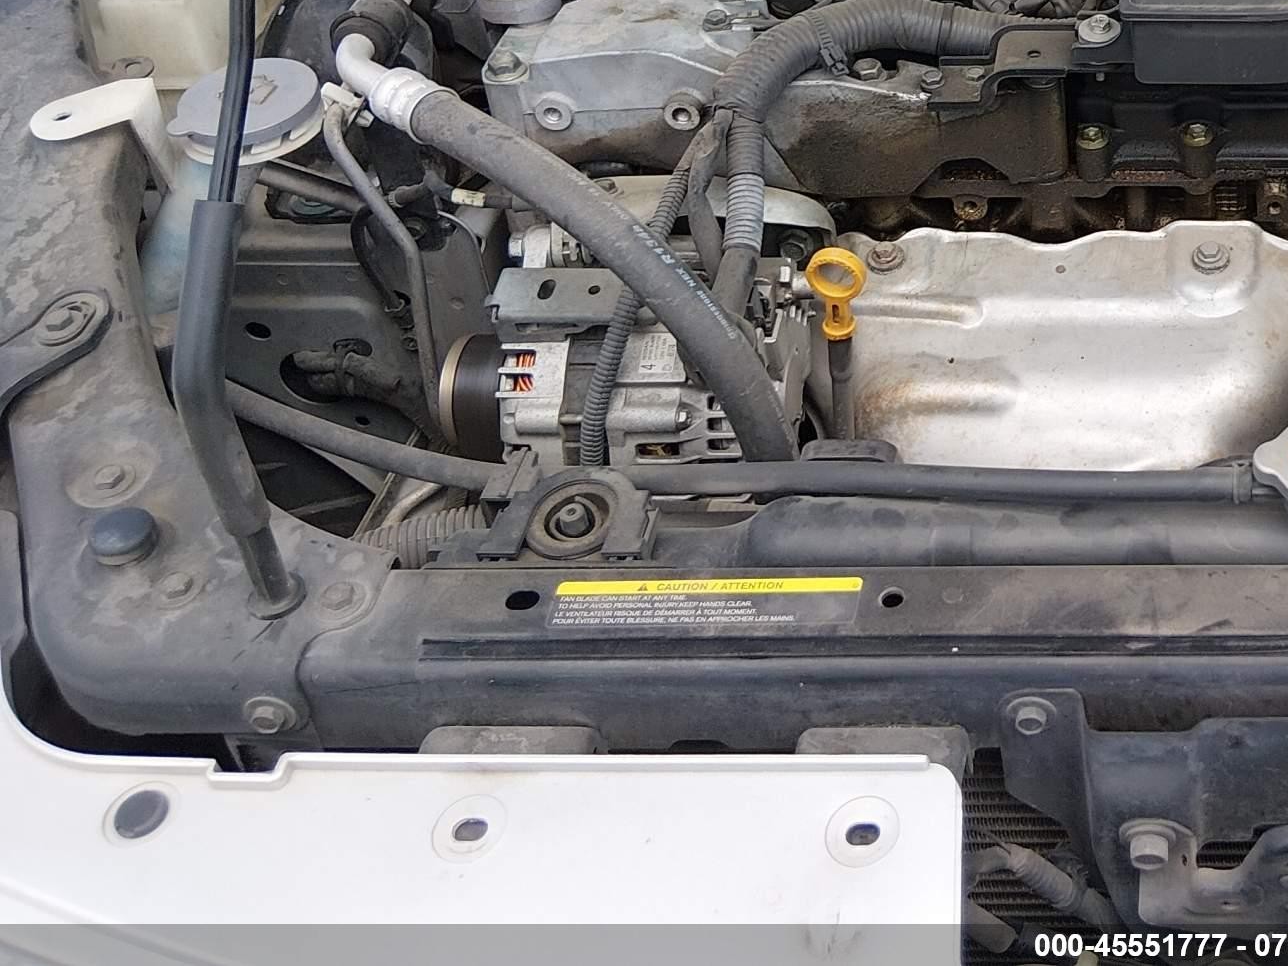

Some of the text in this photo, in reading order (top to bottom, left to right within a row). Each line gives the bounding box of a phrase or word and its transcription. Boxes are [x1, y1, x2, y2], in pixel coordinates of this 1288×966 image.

[656, 583, 708, 591] CAUTION
[720, 581, 784, 590] ATTENTION
[680, 615, 695, 623] PAS
[706, 614, 754, 622] APPROCHER
